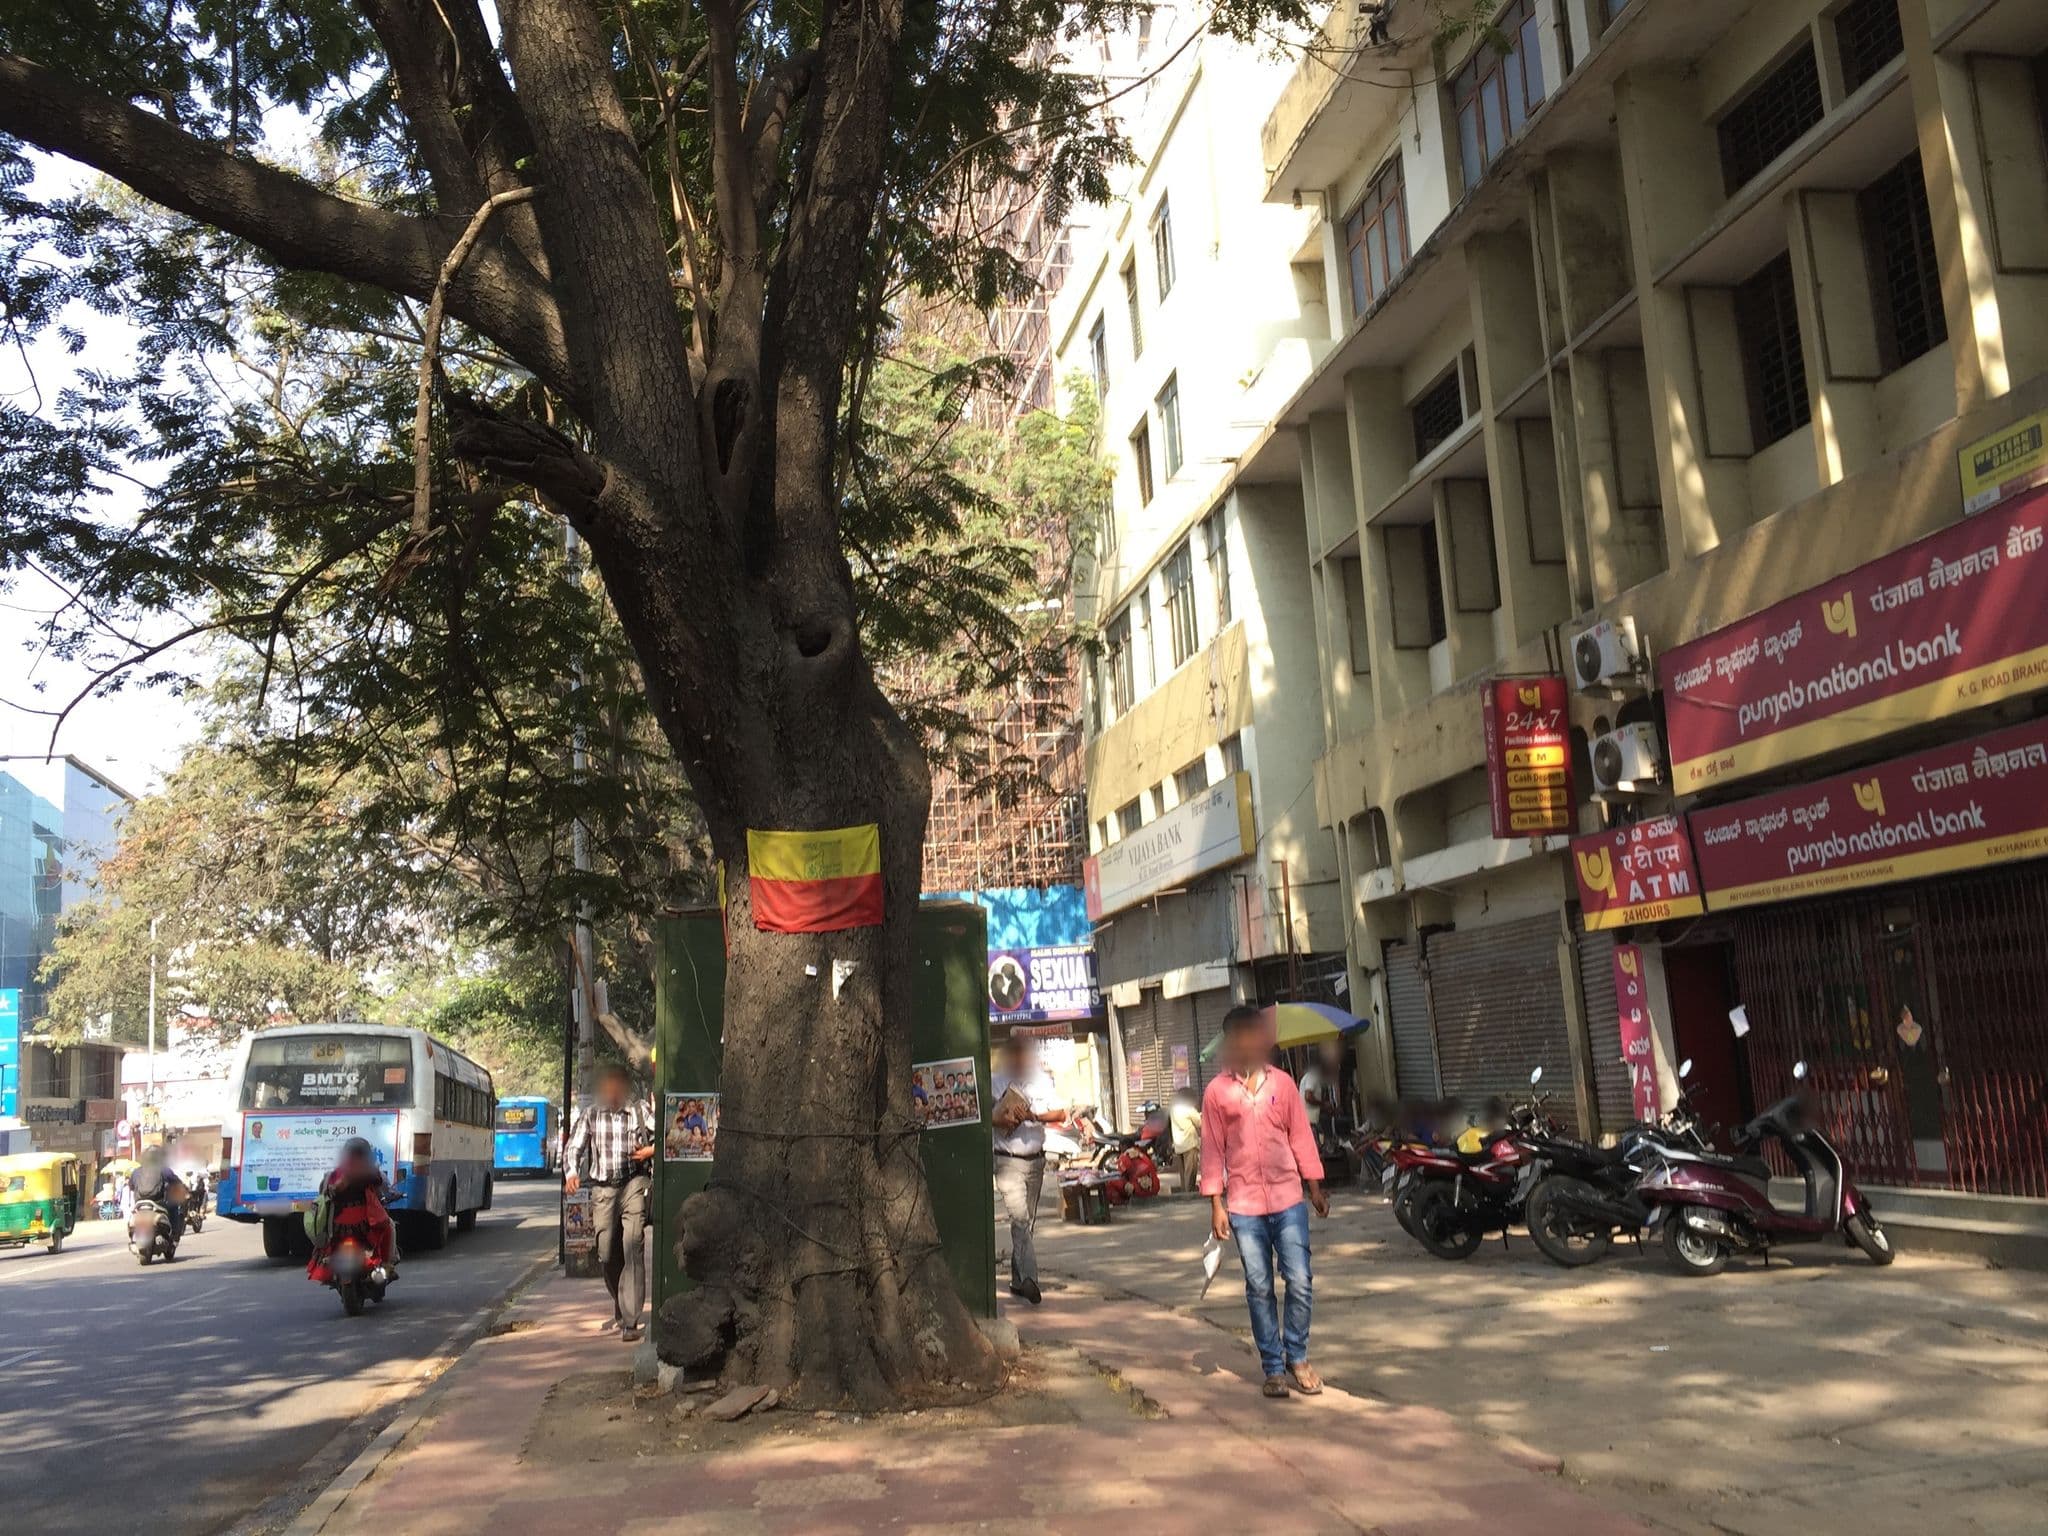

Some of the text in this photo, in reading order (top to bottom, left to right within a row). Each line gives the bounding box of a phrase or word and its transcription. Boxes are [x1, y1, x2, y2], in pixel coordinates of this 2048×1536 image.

[1870, 576, 1925, 613] पंजाब
[2006, 525, 2044, 560] बैंक
[1738, 622, 1962, 736] punjab national bank
[1981, 671, 2010, 692] ROAD
[1911, 763, 1969, 793] पंजाब
[1128, 836, 1157, 867] VIJAYA
[1157, 821, 1183, 852] BANK
[1786, 800, 1986, 874] punjab national bank
[1986, 839, 2041, 857] EXCHANGE
[1850, 864, 1895, 881] EXCHANGE
[1030, 955, 1097, 992] SEXUAL
[1030, 988, 1100, 1010] PROBLEMS
[303, 1072, 360, 1086] BMTC
[331, 1126, 357, 1138] 2018
